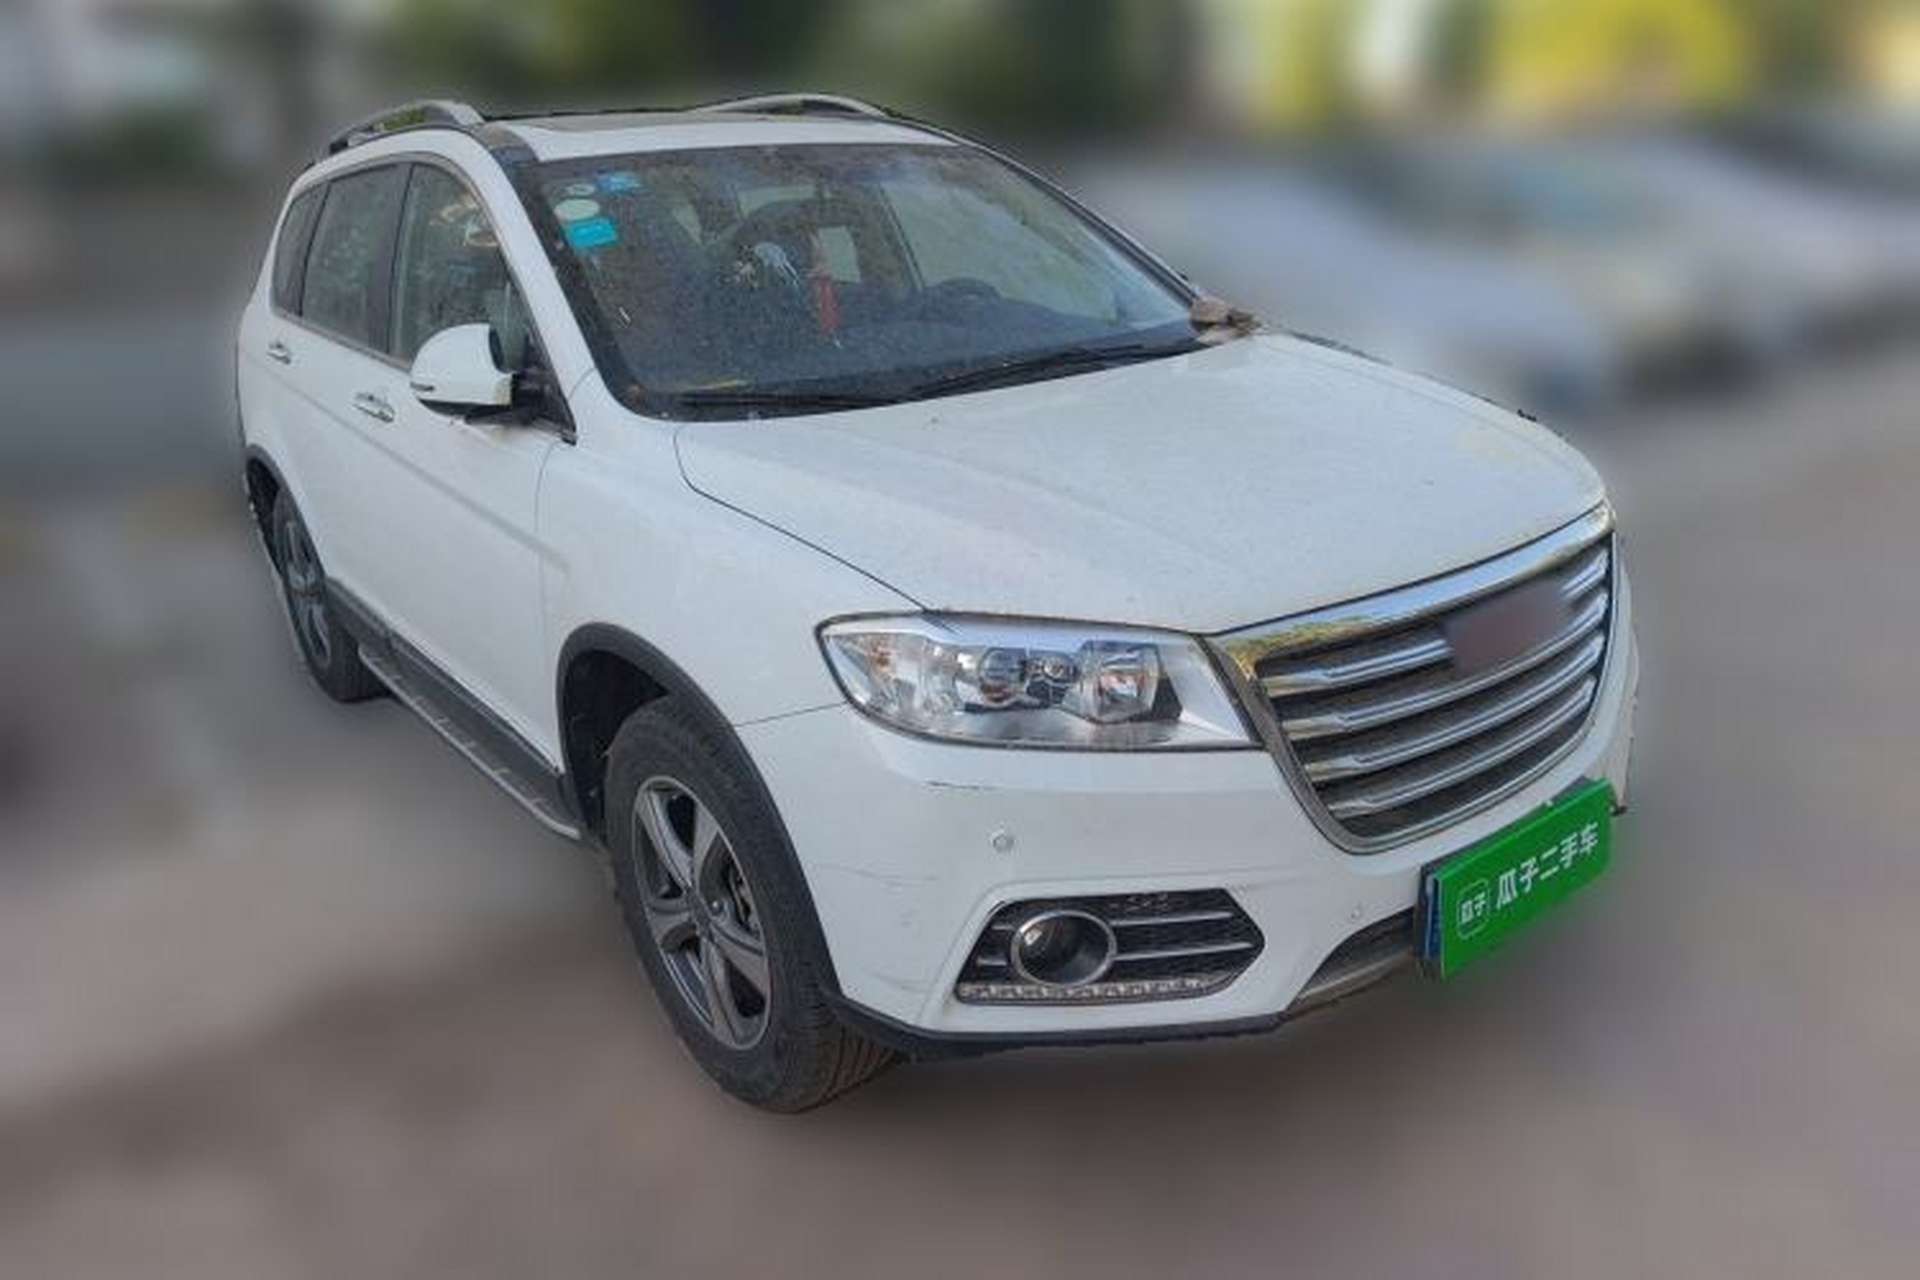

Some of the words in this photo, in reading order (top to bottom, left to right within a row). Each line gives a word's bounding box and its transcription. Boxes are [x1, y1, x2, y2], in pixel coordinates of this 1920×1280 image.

[1496, 822, 1599, 910] 瓜子二手车
